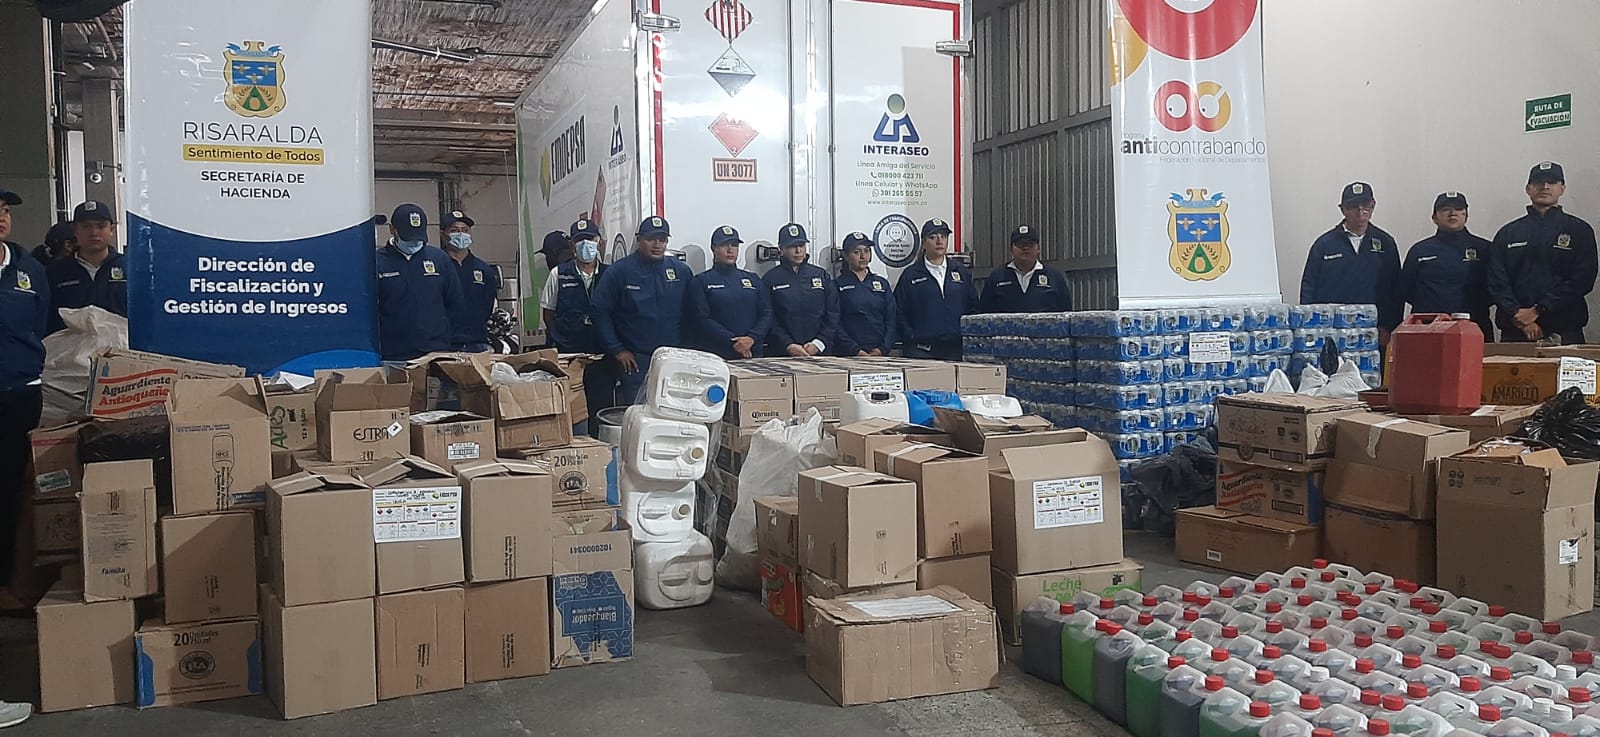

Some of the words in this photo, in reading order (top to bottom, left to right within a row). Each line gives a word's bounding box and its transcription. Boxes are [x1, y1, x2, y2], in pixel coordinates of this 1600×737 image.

[1534, 103, 1552, 113] RUTA
[1553, 101, 1564, 110] DE
[184, 121, 323, 144] RISARALDA
[863, 145, 929, 157] INTERASEO
[1121, 136, 1266, 155] anticontrabando
[187, 147, 263, 160] Sentimiento
[265, 149, 282, 161] de
[284, 150, 321, 162] Todos
[716, 162, 730, 177] UN
[731, 163, 754, 178] 3077
[876, 161, 898, 170] Amiga
[899, 161, 910, 169] del
[911, 162, 936, 170] Servicio
[201, 170, 284, 184] SECRETARÍA
[286, 172, 305, 184] DE
[220, 187, 291, 199] HACIENDA
[905, 181, 938, 190] WhatsApp
[198, 256, 287, 272] Dirección
[290, 257, 315, 272] de
[190, 278, 310, 293] Fiscalización
[312, 282, 324, 297] y
[164, 299, 238, 314] Gestión
[241, 299, 266, 314] de
[269, 300, 348, 317] Ingresos
[101, 375, 172, 397] Aguardiente
[98, 385, 171, 406] Antioqueño
[553, 455, 567, 468] 20
[1042, 575, 1082, 593] Leche
[571, 611, 617, 625] Blanqueador
[174, 632, 190, 647] 20
